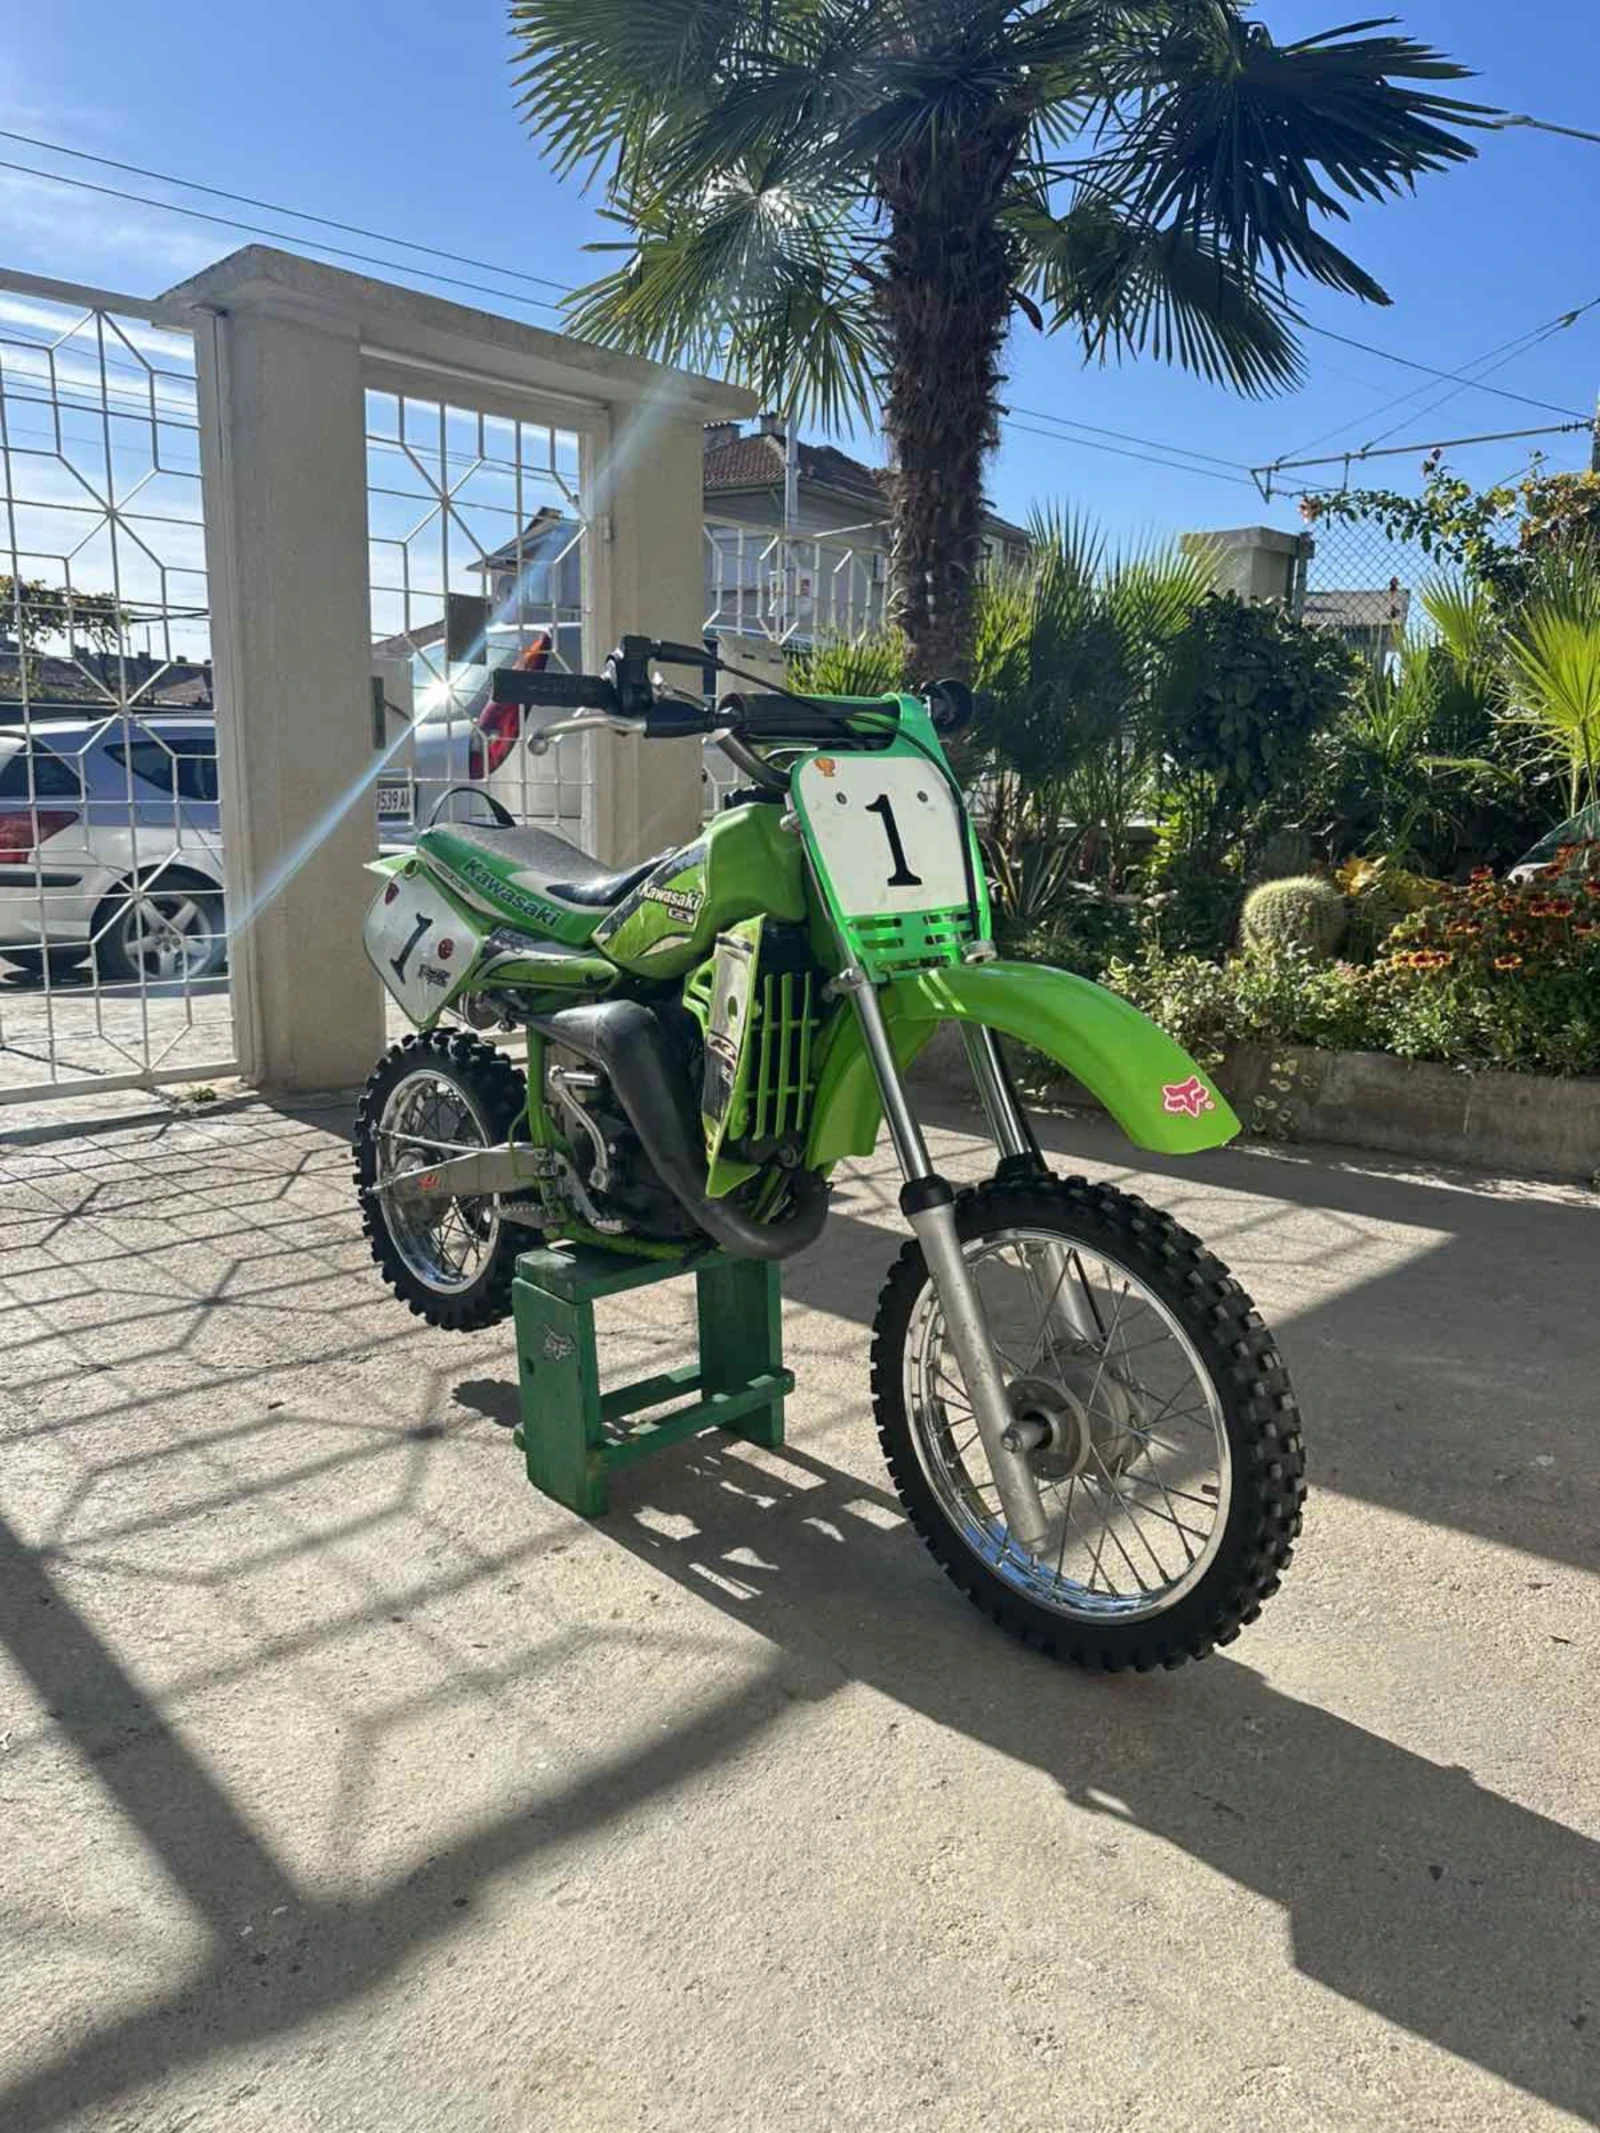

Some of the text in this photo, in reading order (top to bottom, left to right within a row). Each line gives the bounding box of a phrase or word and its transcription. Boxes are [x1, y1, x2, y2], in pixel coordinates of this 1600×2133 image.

[866, 794, 922, 886] 1
[463, 859, 561, 926] Kawasaki
[640, 881, 704, 911] Kawasaki
[390, 912, 433, 984] 1
